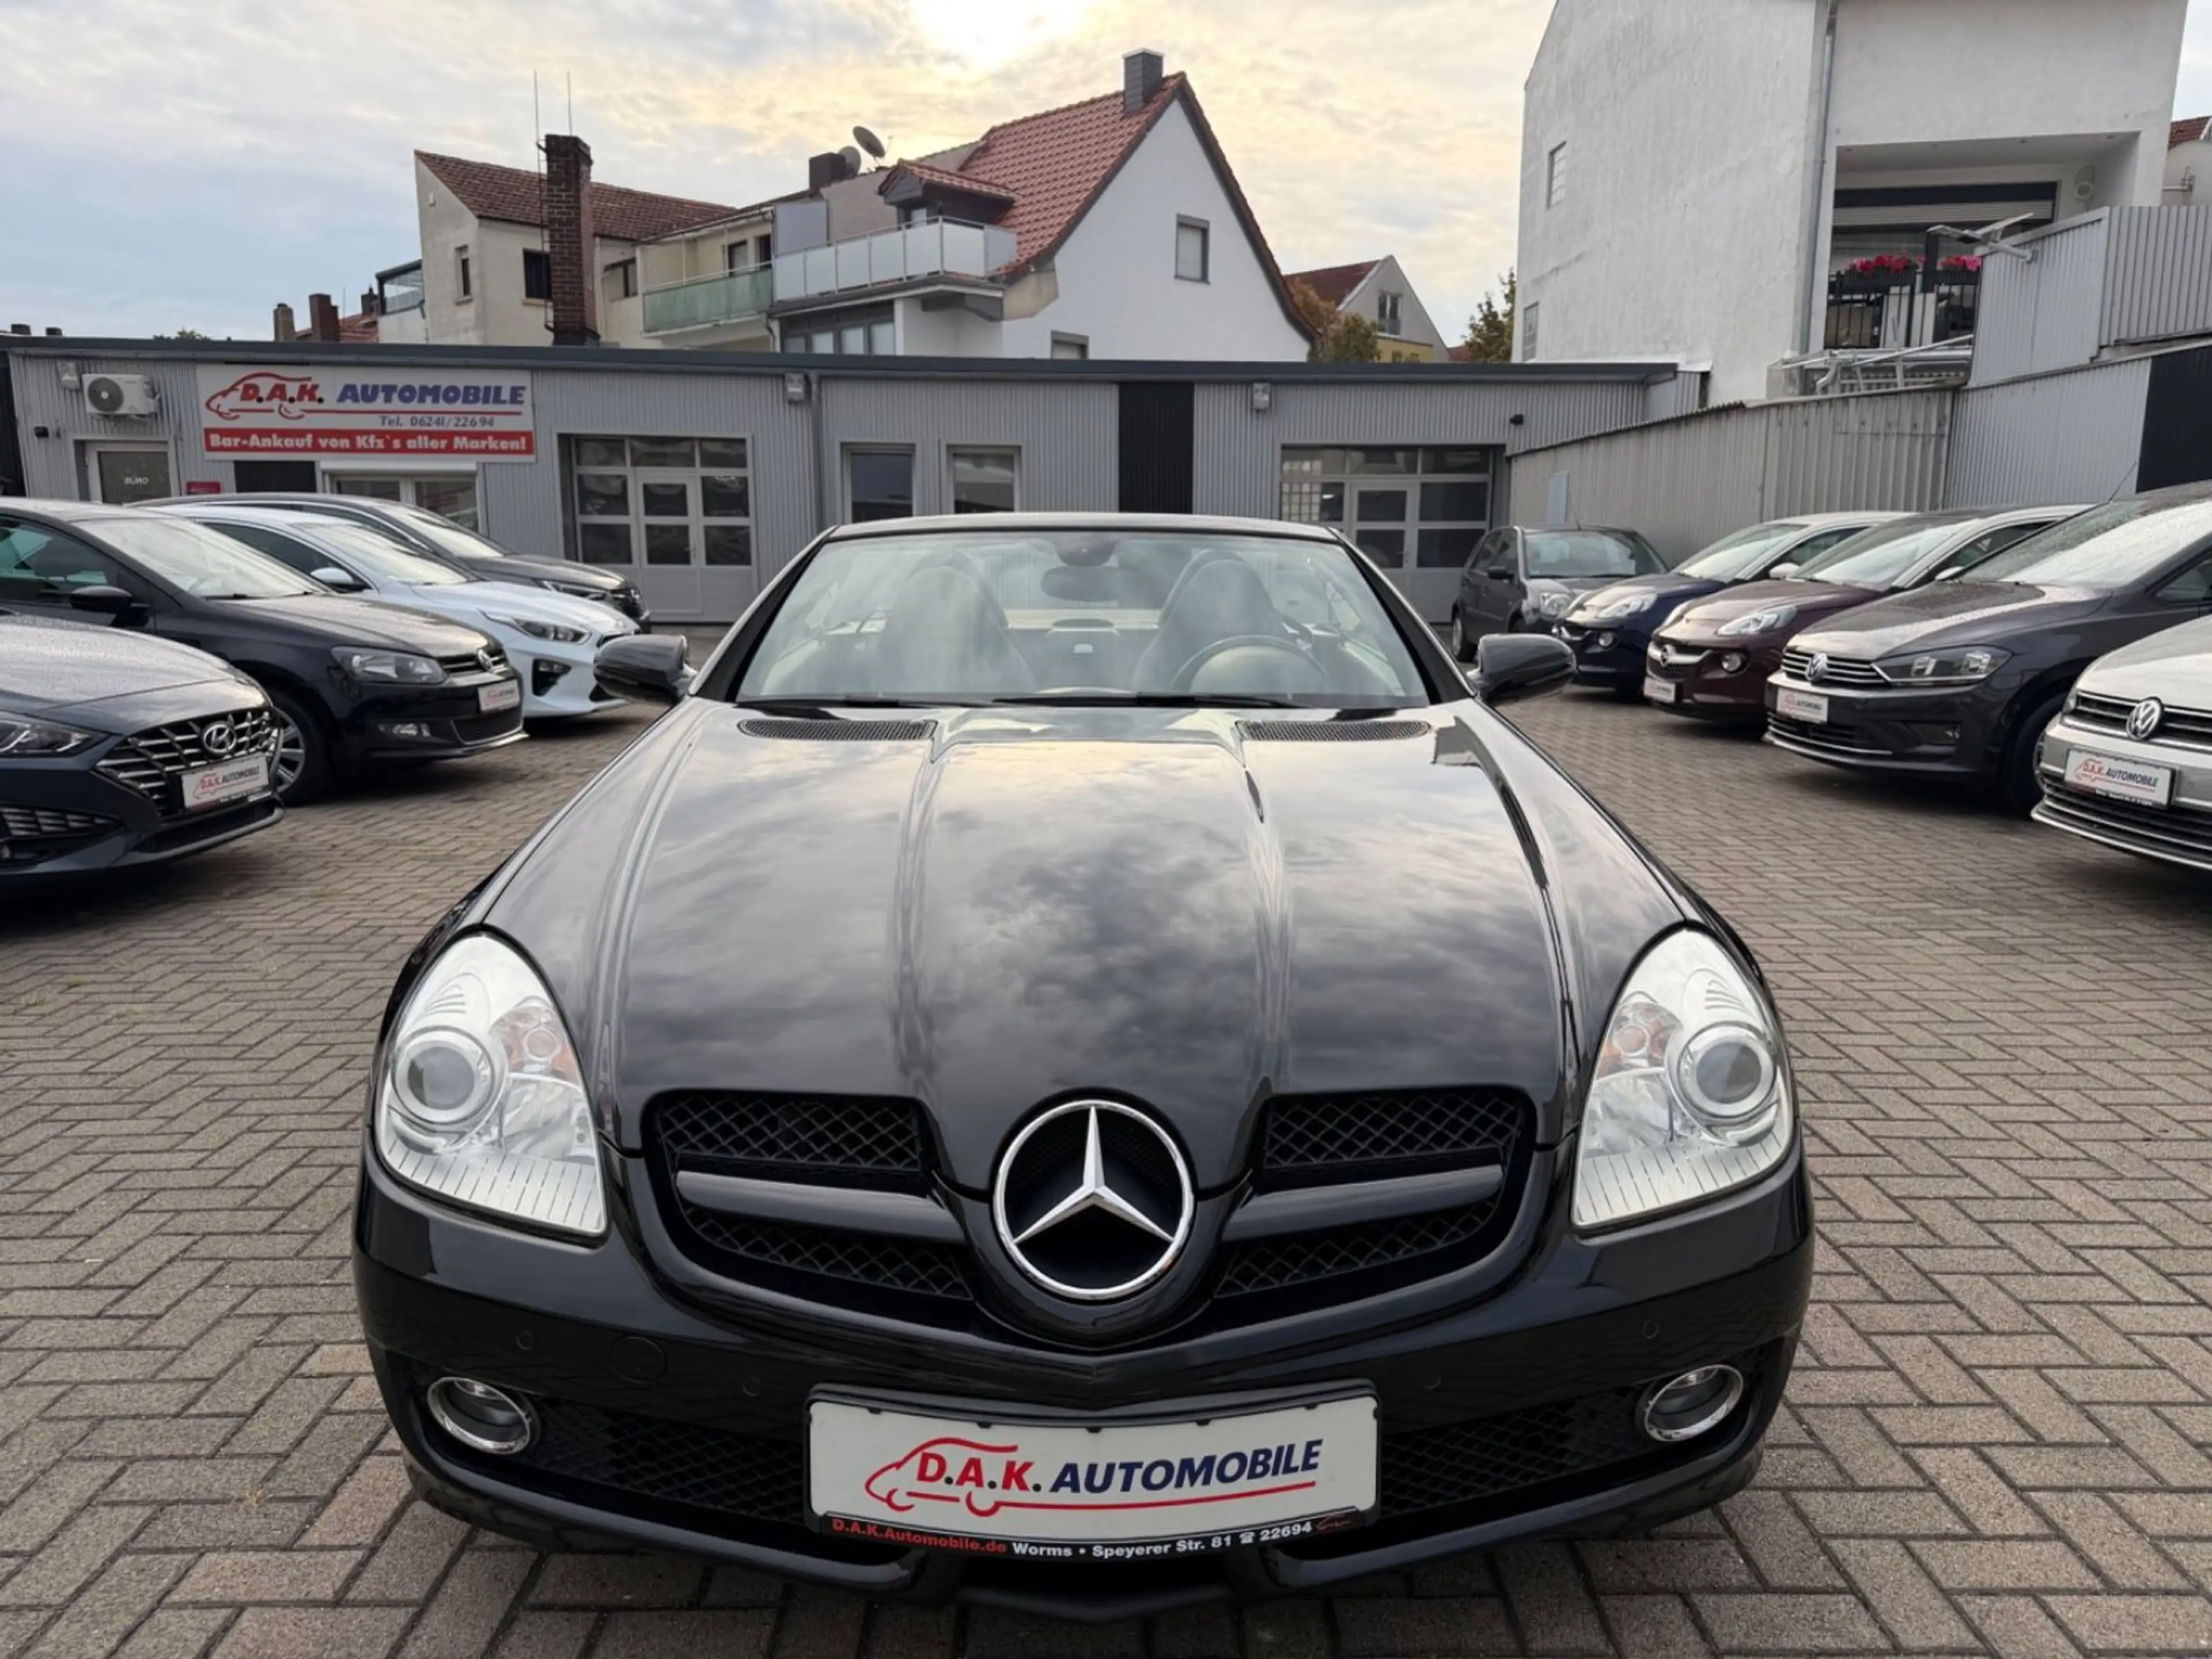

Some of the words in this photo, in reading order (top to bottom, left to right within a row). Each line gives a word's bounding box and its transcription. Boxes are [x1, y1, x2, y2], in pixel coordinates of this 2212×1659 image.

[240, 383, 324, 403] D.A.K.
[336, 384, 526, 405] AUTOMOBILE
[380, 415, 403, 427] Tel.
[410, 415, 494, 428] 06241/22694
[209, 433, 313, 448] Bar-Ankauf
[319, 437, 350, 448] von
[406, 435, 448, 449] aller
[453, 436, 527, 450] Marken!
[2105, 767, 2159, 787] AUTOMOBILE
[916, 1452, 1042, 1492] D.A.K.
[1049, 1438, 1324, 1494] AUTOMOBILE
[832, 1518, 1007, 1554] D.A.K.Automobile.de
[1012, 1541, 1073, 1557] Worms
[1092, 1540, 1172, 1559] Speyerer
[1176, 1539, 1206, 1552] Str.
[1211, 1535, 1232, 1548] 81
[1260, 1520, 1313, 1542] 22694
